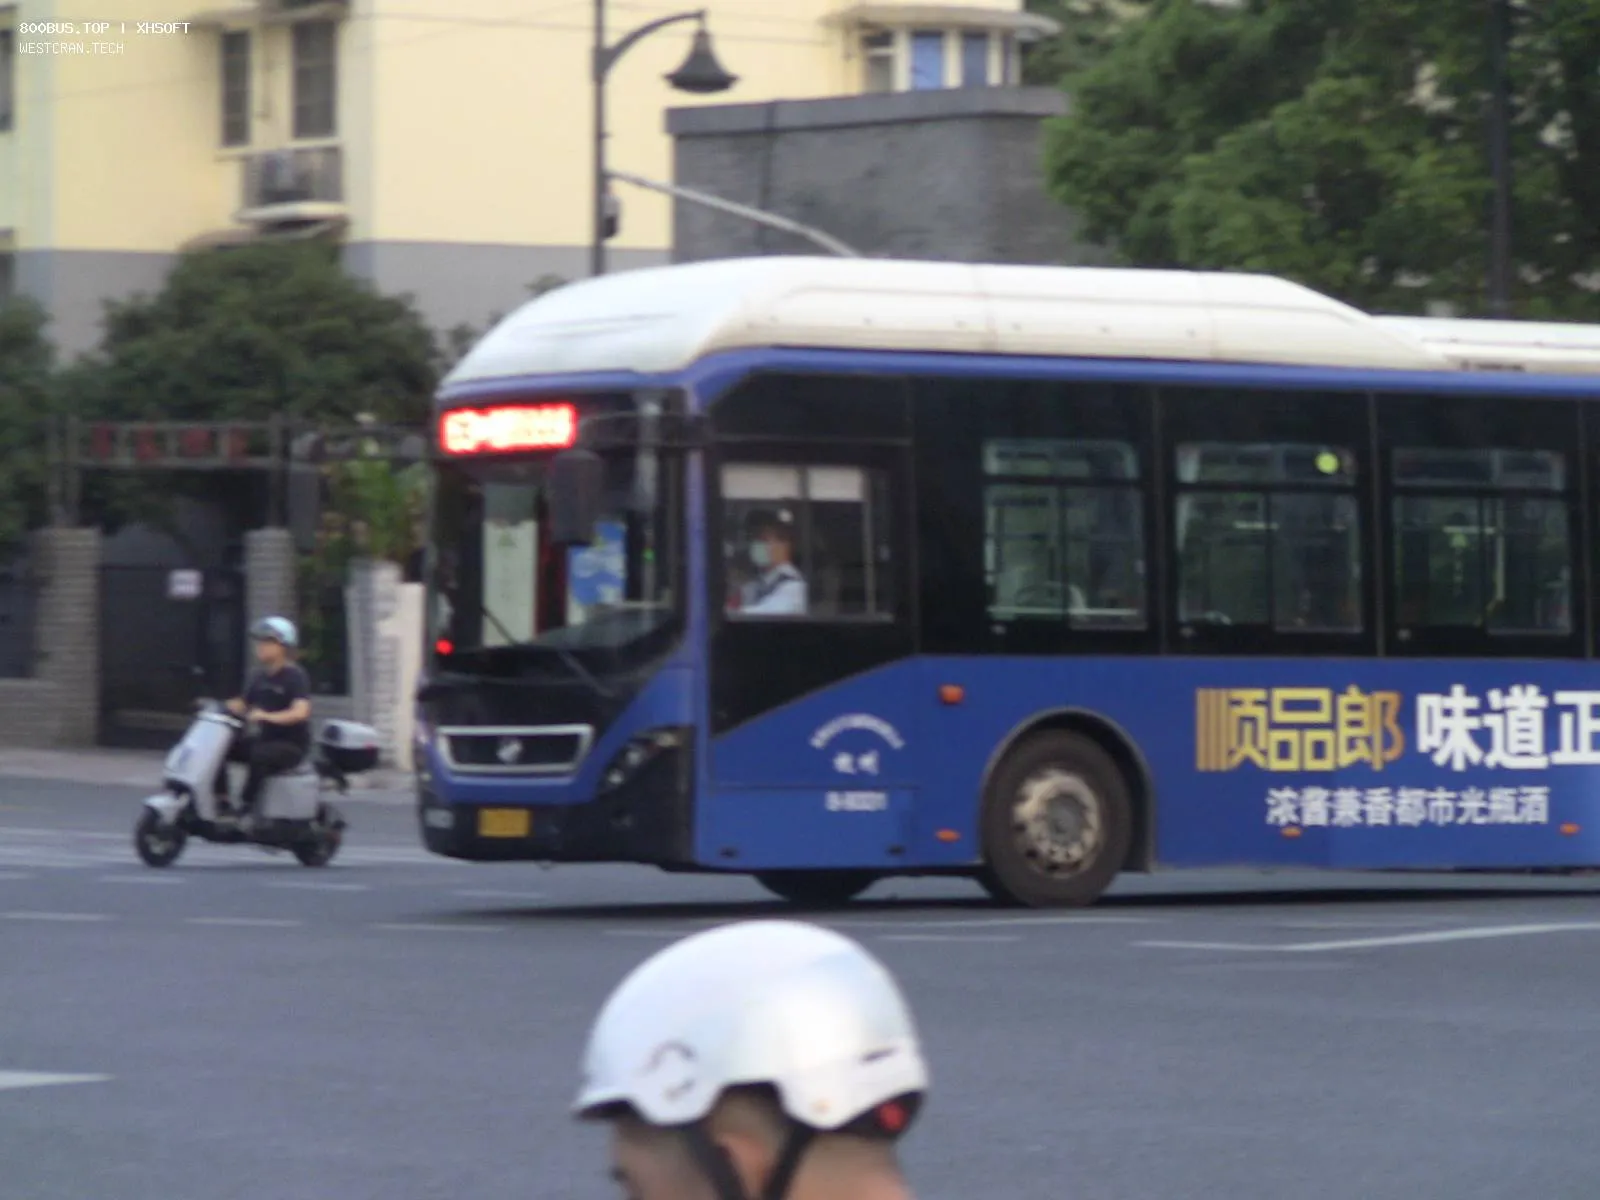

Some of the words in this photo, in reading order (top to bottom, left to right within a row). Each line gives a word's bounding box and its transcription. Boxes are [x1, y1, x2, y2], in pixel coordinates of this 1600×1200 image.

[1195, 684, 1405, 772] 顺品郎
[1416, 684, 1600, 772] 味道正
